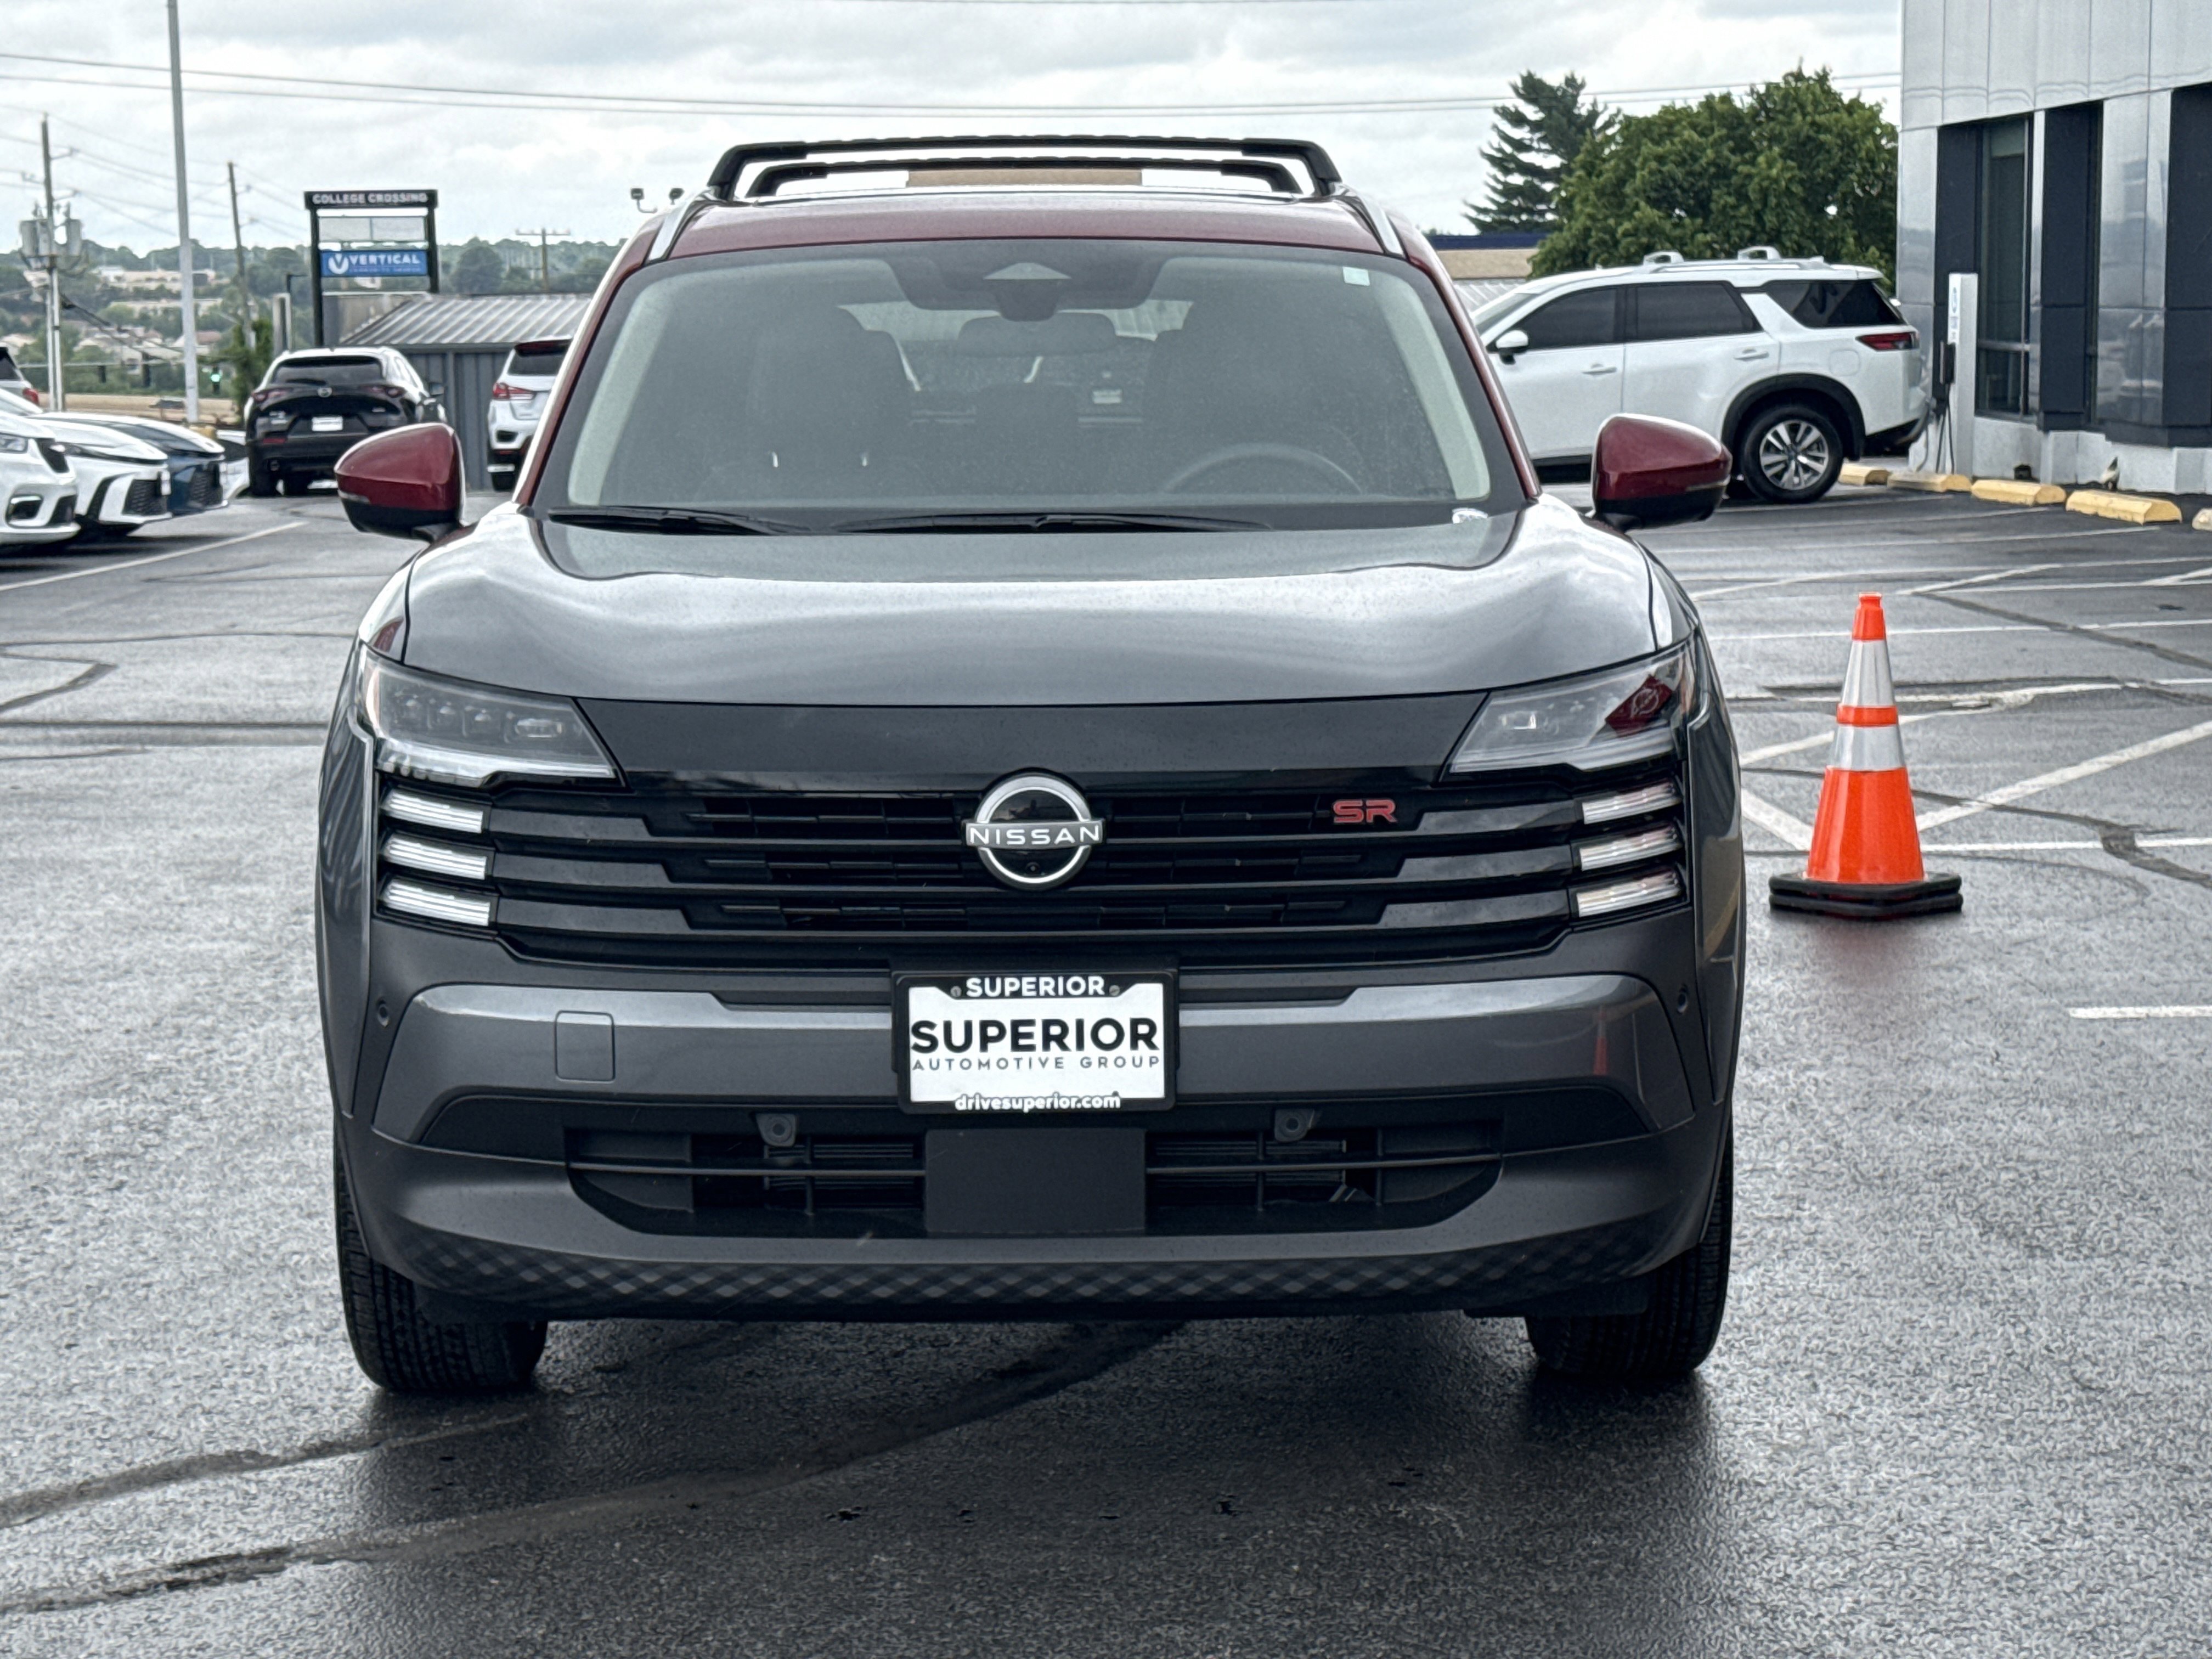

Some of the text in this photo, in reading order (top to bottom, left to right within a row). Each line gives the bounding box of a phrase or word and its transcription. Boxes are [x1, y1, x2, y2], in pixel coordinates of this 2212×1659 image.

[312, 193, 428, 205] COLLEGE CROSSING
[349, 253, 421, 266] VERTICAL
[1333, 799, 1397, 823] SR
[970, 825, 1099, 845] NISSAN
[966, 976, 1105, 997] SUPERIOR
[911, 1017, 1160, 1053] SUPERIOR
[912, 1056, 1160, 1071] AUTOMOTIVE GROUP
[955, 1092, 1121, 1113] drivesuperior.com
